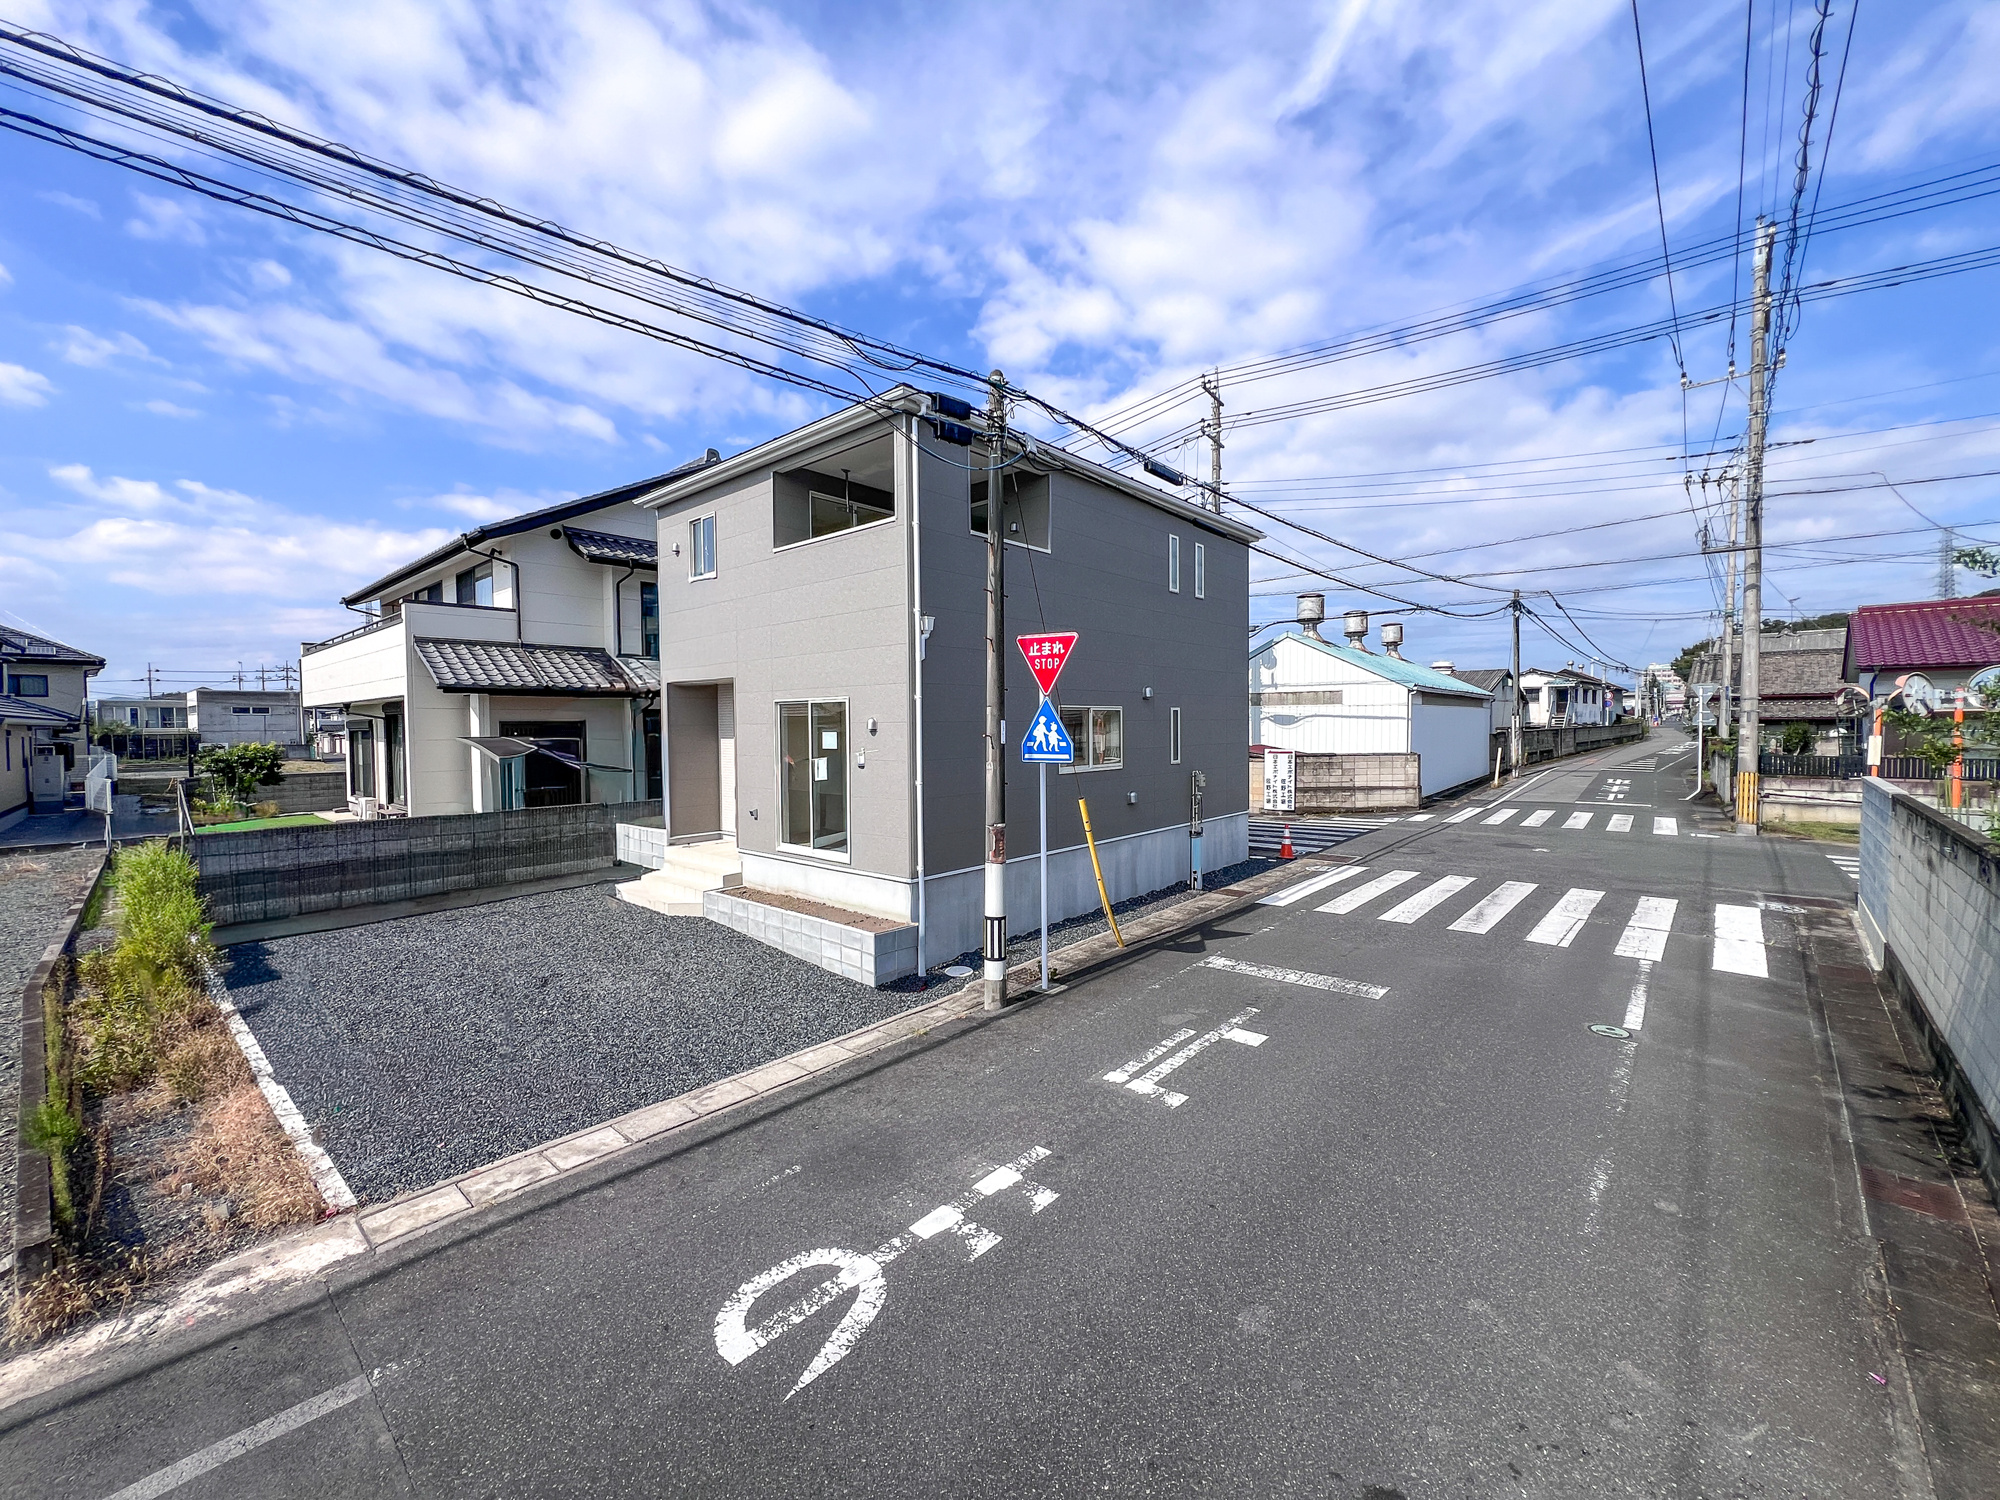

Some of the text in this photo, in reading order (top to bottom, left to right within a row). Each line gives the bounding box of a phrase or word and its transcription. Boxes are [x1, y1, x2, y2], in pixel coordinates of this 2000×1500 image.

[1028, 641, 1065, 656] 止まれ
[1034, 657, 1060, 670] STOP
